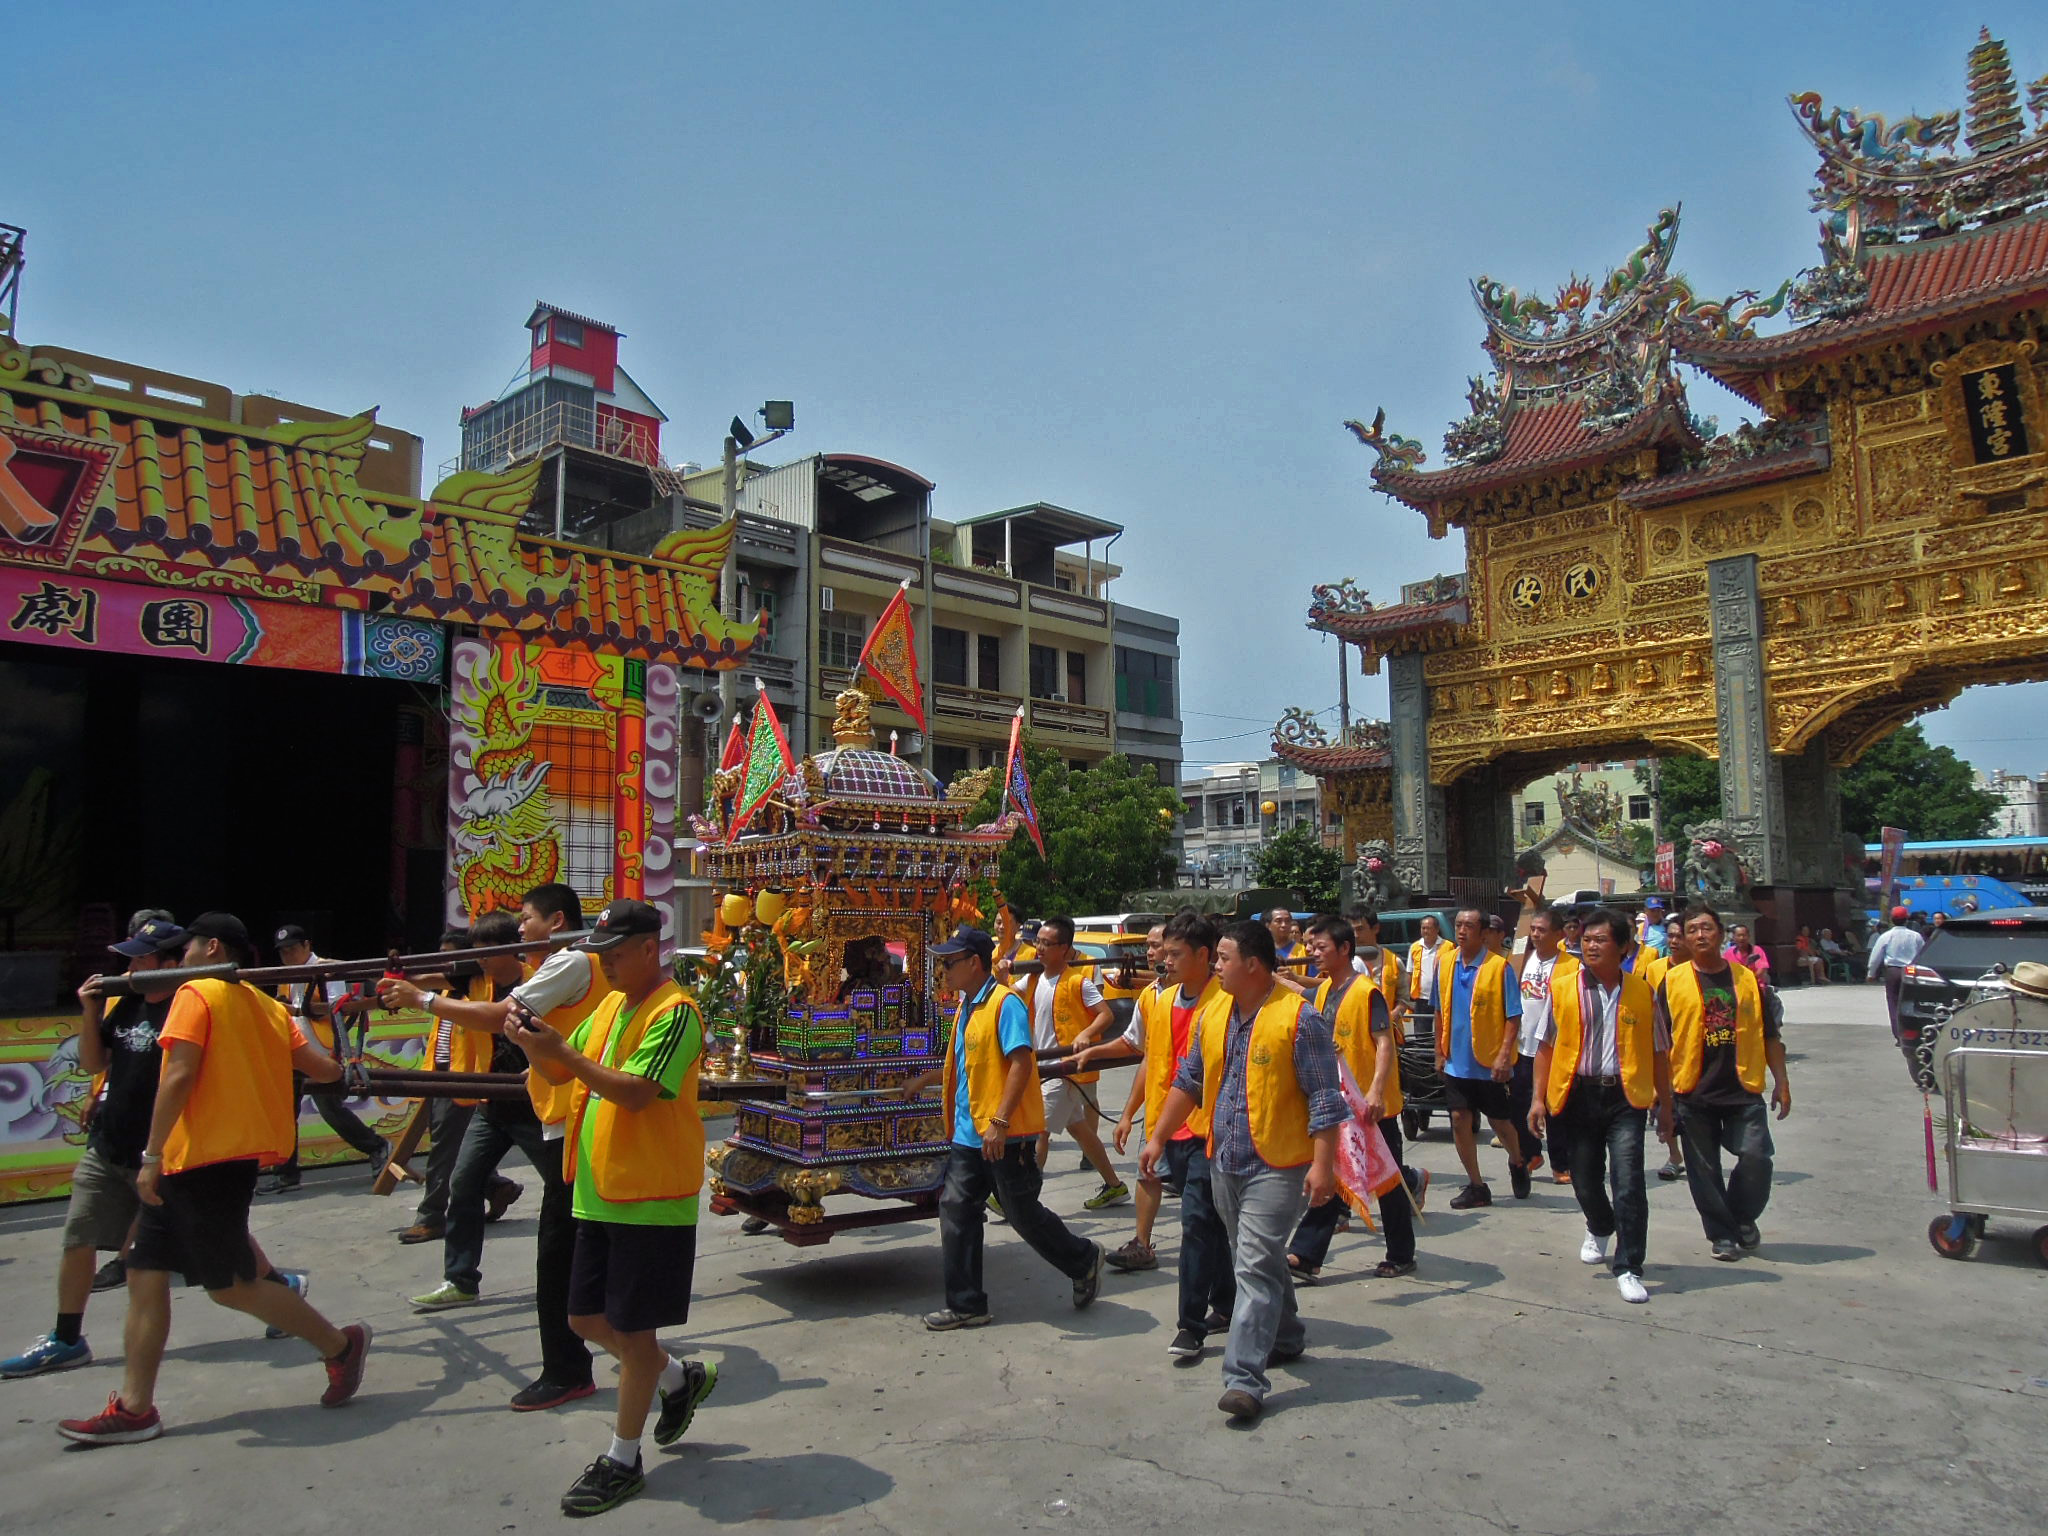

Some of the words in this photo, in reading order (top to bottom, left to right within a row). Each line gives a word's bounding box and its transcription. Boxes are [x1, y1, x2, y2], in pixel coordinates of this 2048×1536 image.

[1977, 371, 2013, 456] 東隆宮
[9, 581, 211, 655] 劇團
